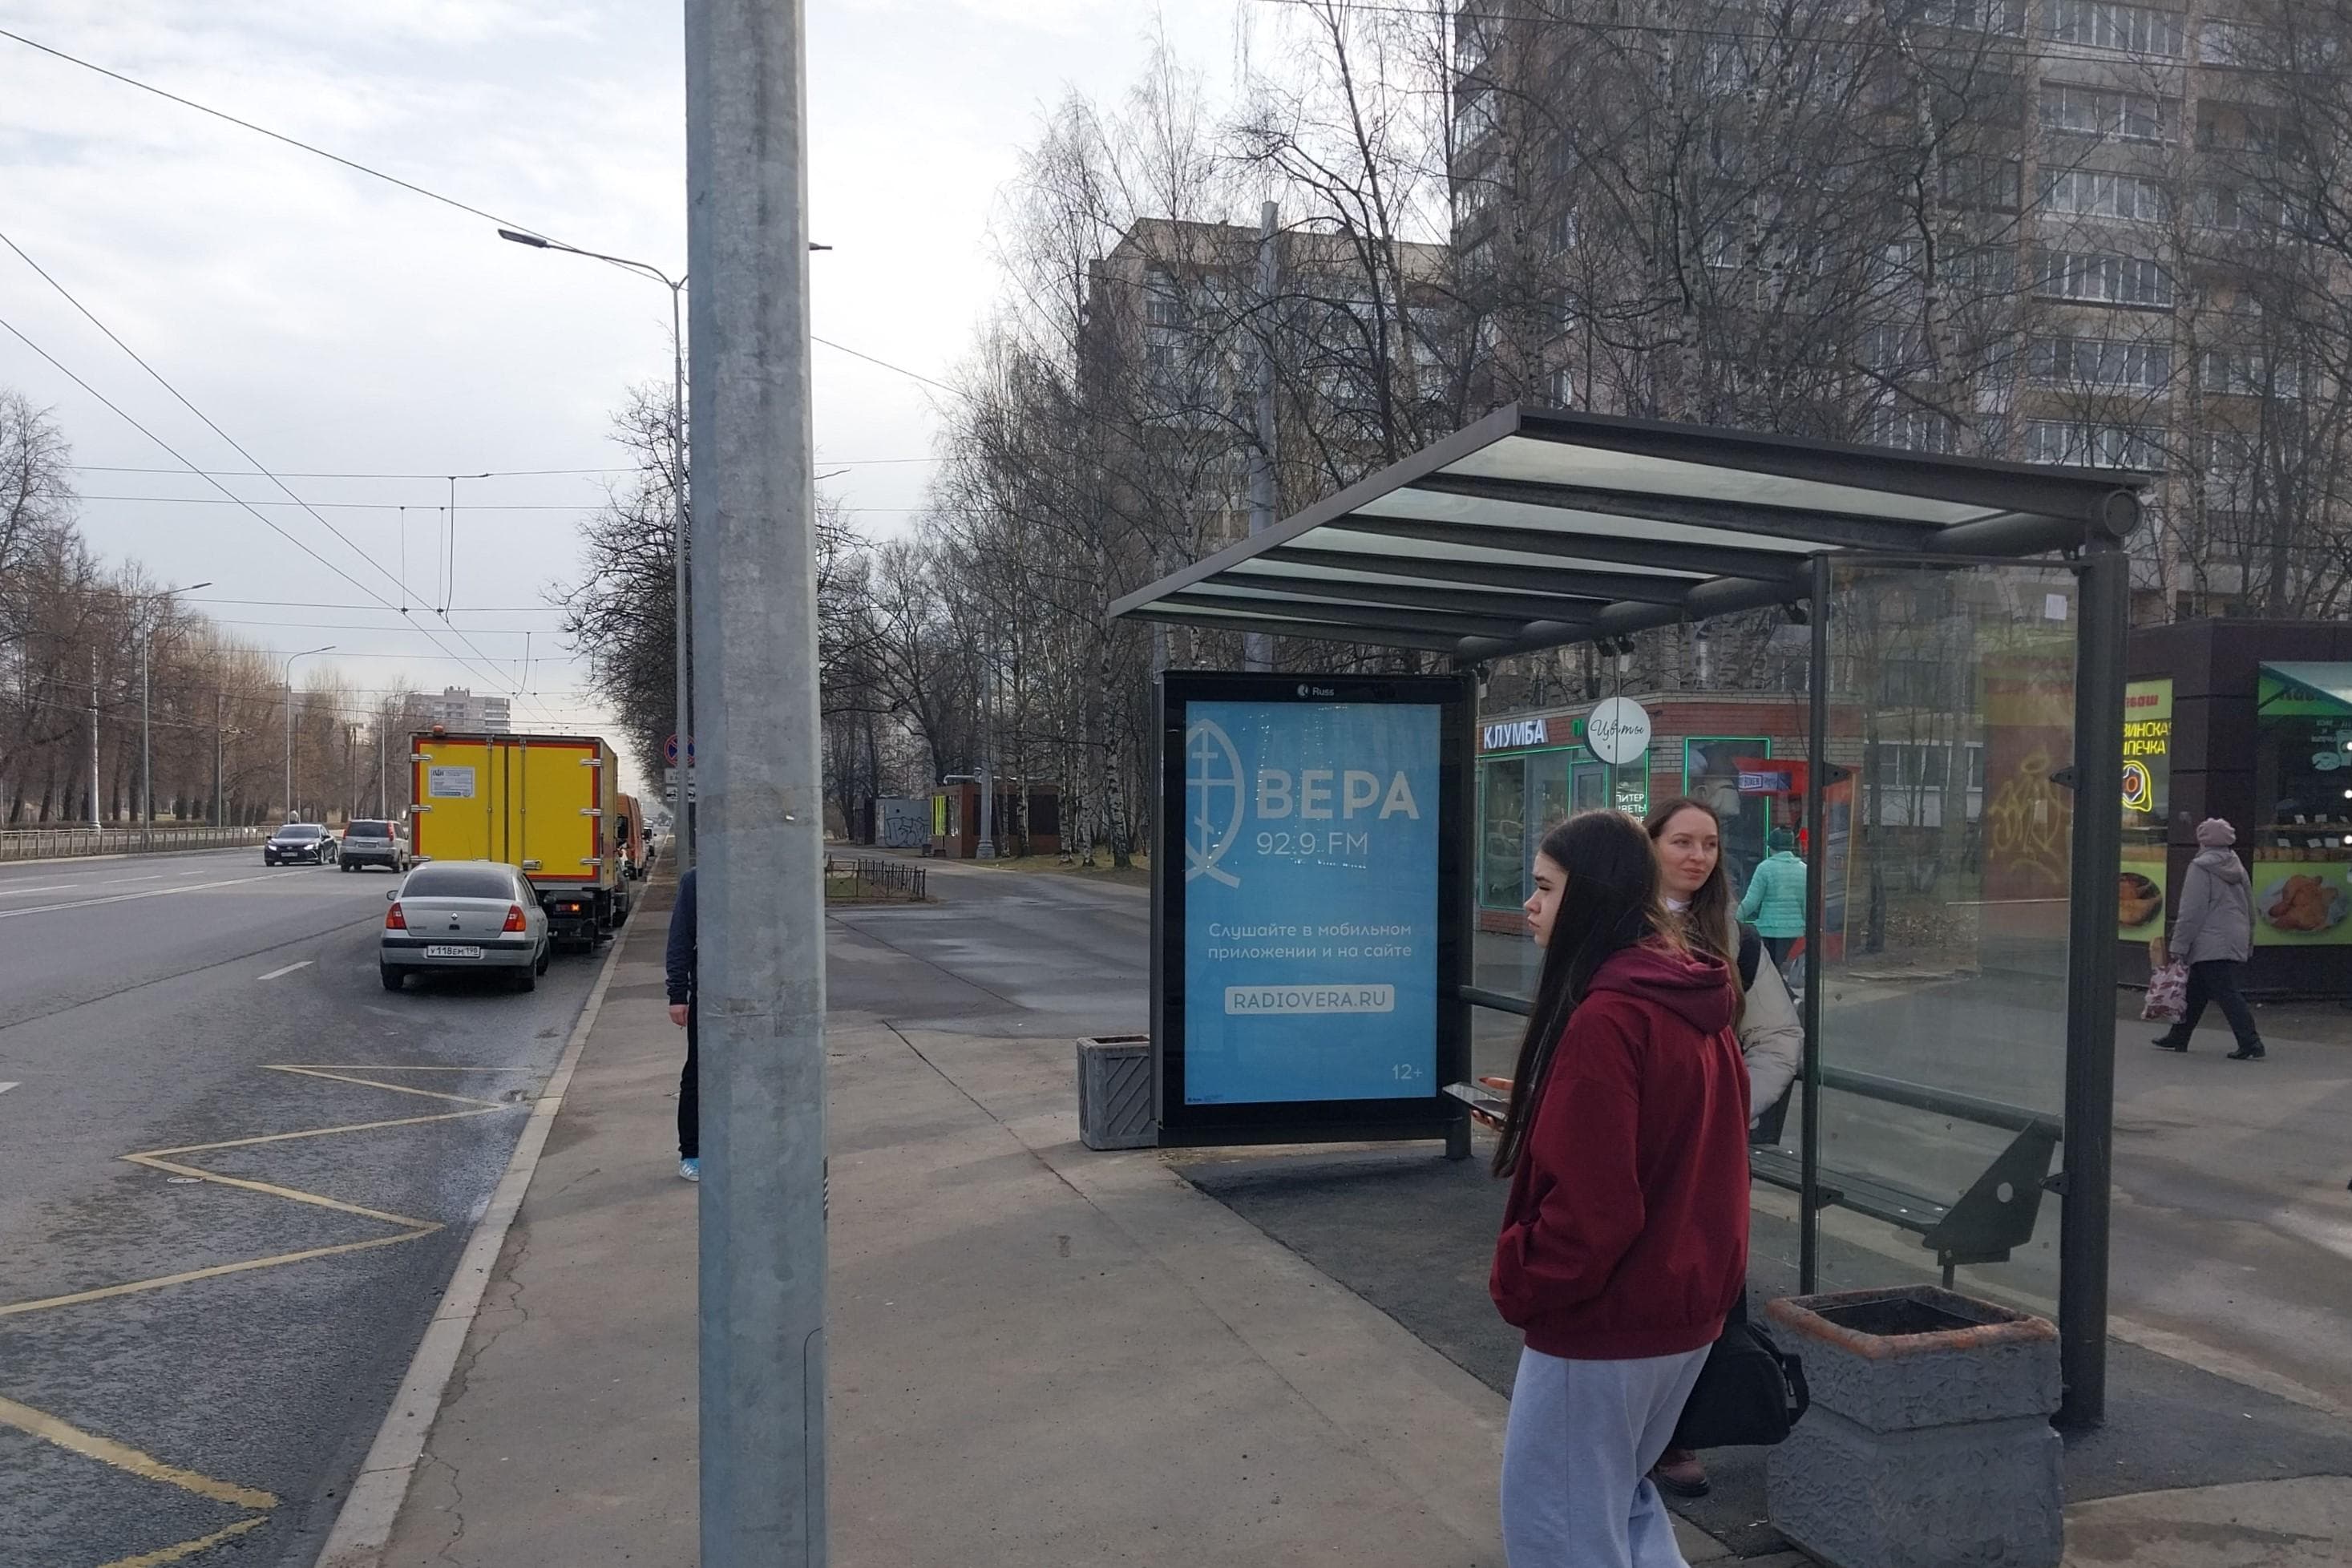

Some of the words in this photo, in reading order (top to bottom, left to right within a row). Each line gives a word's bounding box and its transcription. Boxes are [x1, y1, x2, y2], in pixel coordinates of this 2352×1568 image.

[1312, 687, 1335, 696] Russ
[1484, 719, 1546, 749] КЛУМБА
[1256, 769, 1420, 819] ВЕРА
[1328, 831, 1368, 855] FM
[1209, 923, 1296, 940] Слушайте
[1303, 926, 1312, 936] в
[1318, 922, 1412, 936] мобильном
[1208, 948, 1316, 962] приложении
[1323, 947, 1332, 957] и
[1338, 947, 1358, 957] на
[1364, 944, 1412, 957] сайте
[1234, 991, 1386, 1008] RADIOVERA.RU
[1392, 1064, 1423, 1080] 12+
